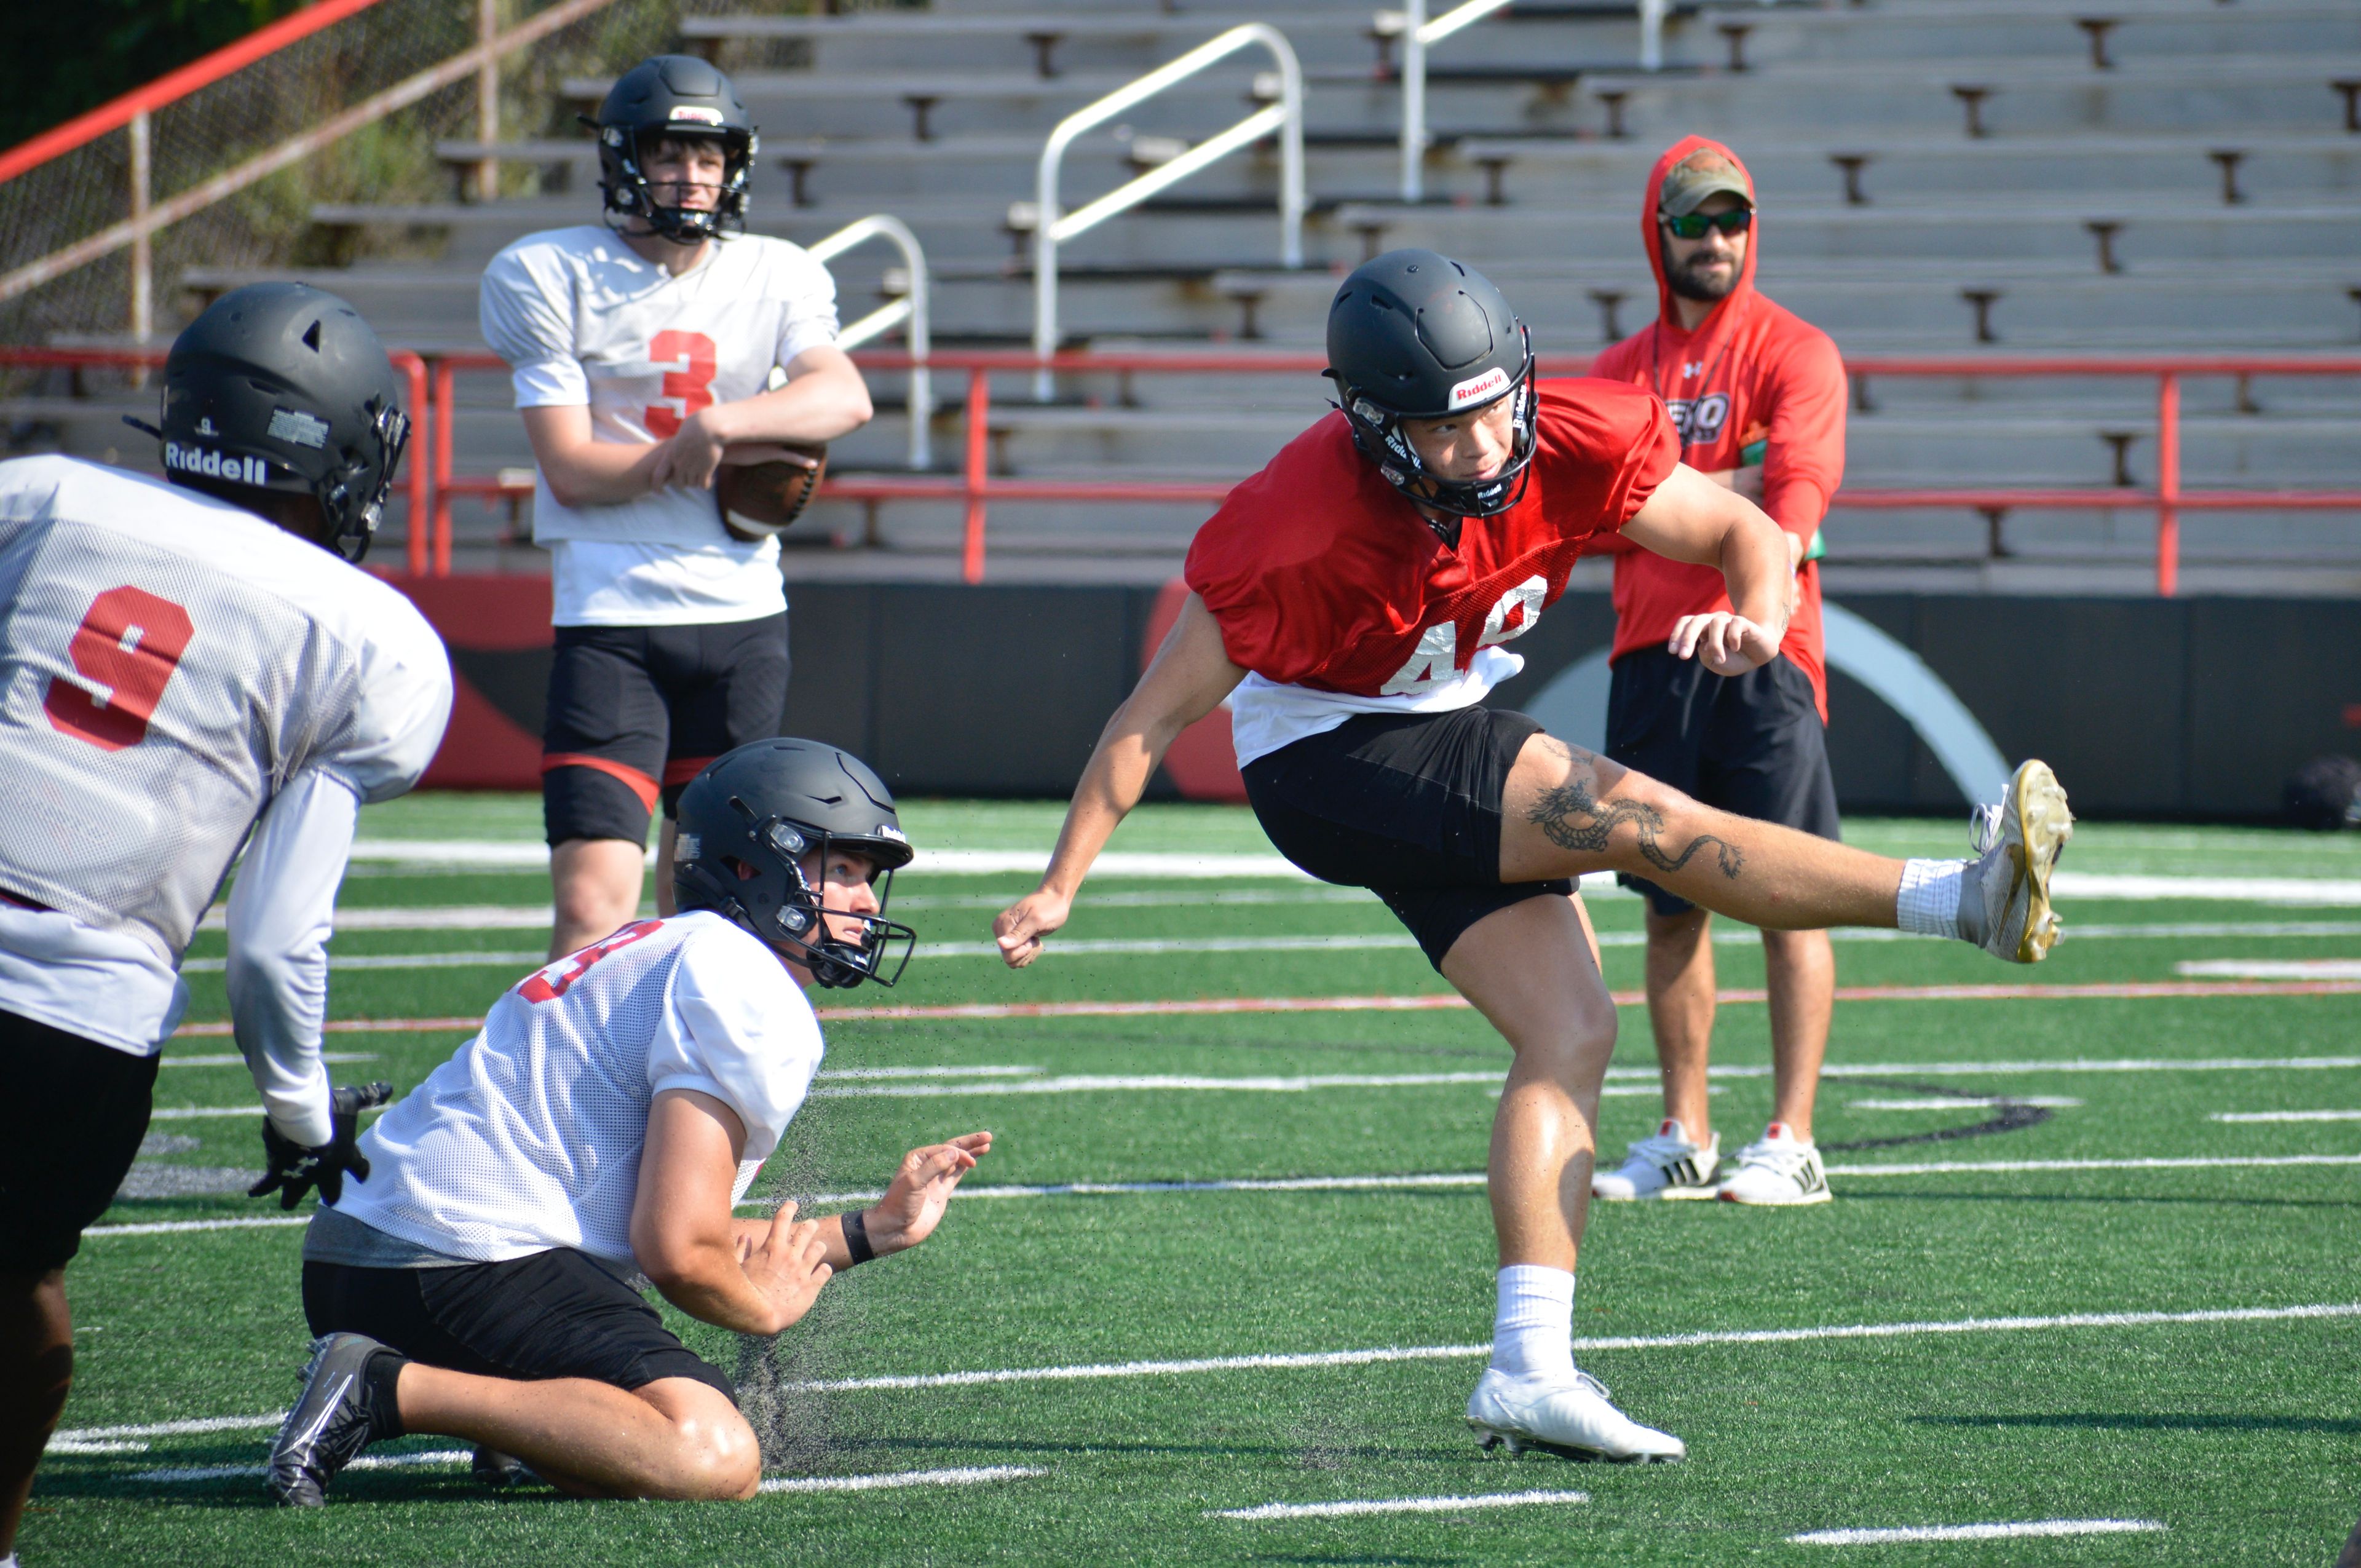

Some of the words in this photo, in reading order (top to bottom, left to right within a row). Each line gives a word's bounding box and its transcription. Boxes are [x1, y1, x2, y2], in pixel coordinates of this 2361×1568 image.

[644, 329, 718, 440] 3
[1457, 374, 1501, 400] Riddell
[165, 442, 266, 485] Riddell
[43, 585, 194, 753] 9
